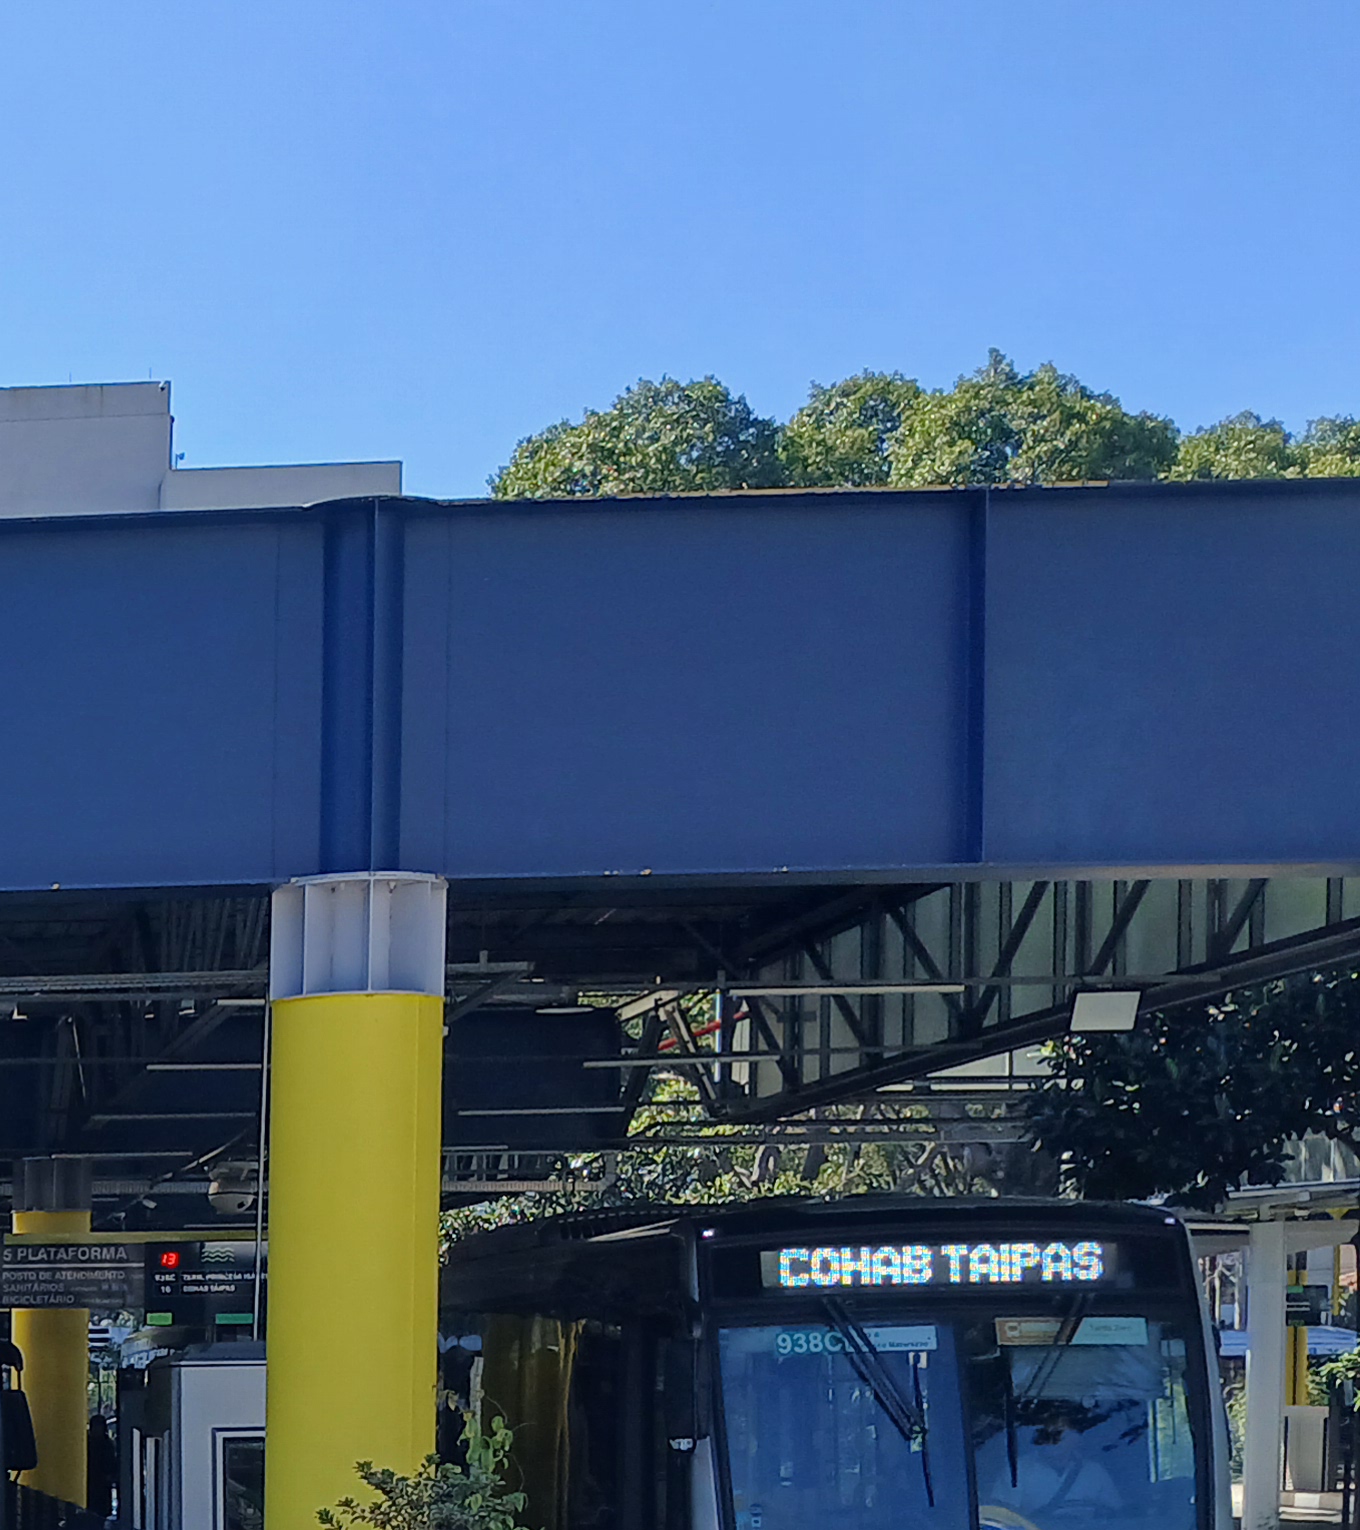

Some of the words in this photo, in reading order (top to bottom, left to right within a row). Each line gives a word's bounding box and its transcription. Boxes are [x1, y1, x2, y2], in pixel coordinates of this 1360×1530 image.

[17, 1247, 127, 1262] PLATAFORMA
[161, 1253, 178, 1266] 13
[779, 1245, 933, 1288] COHAB
[940, 1242, 1105, 1285] TAIPAS
[2, 1271, 37, 1281] POSTO
[39, 1271, 52, 1281] DE
[55, 1270, 126, 1280] ATENDIMENTO
[2, 1282, 65, 1293] SANITÁRIOS
[2, 1294, 75, 1305] BICICLETÁRIO
[777, 1331, 843, 1354] 938C
